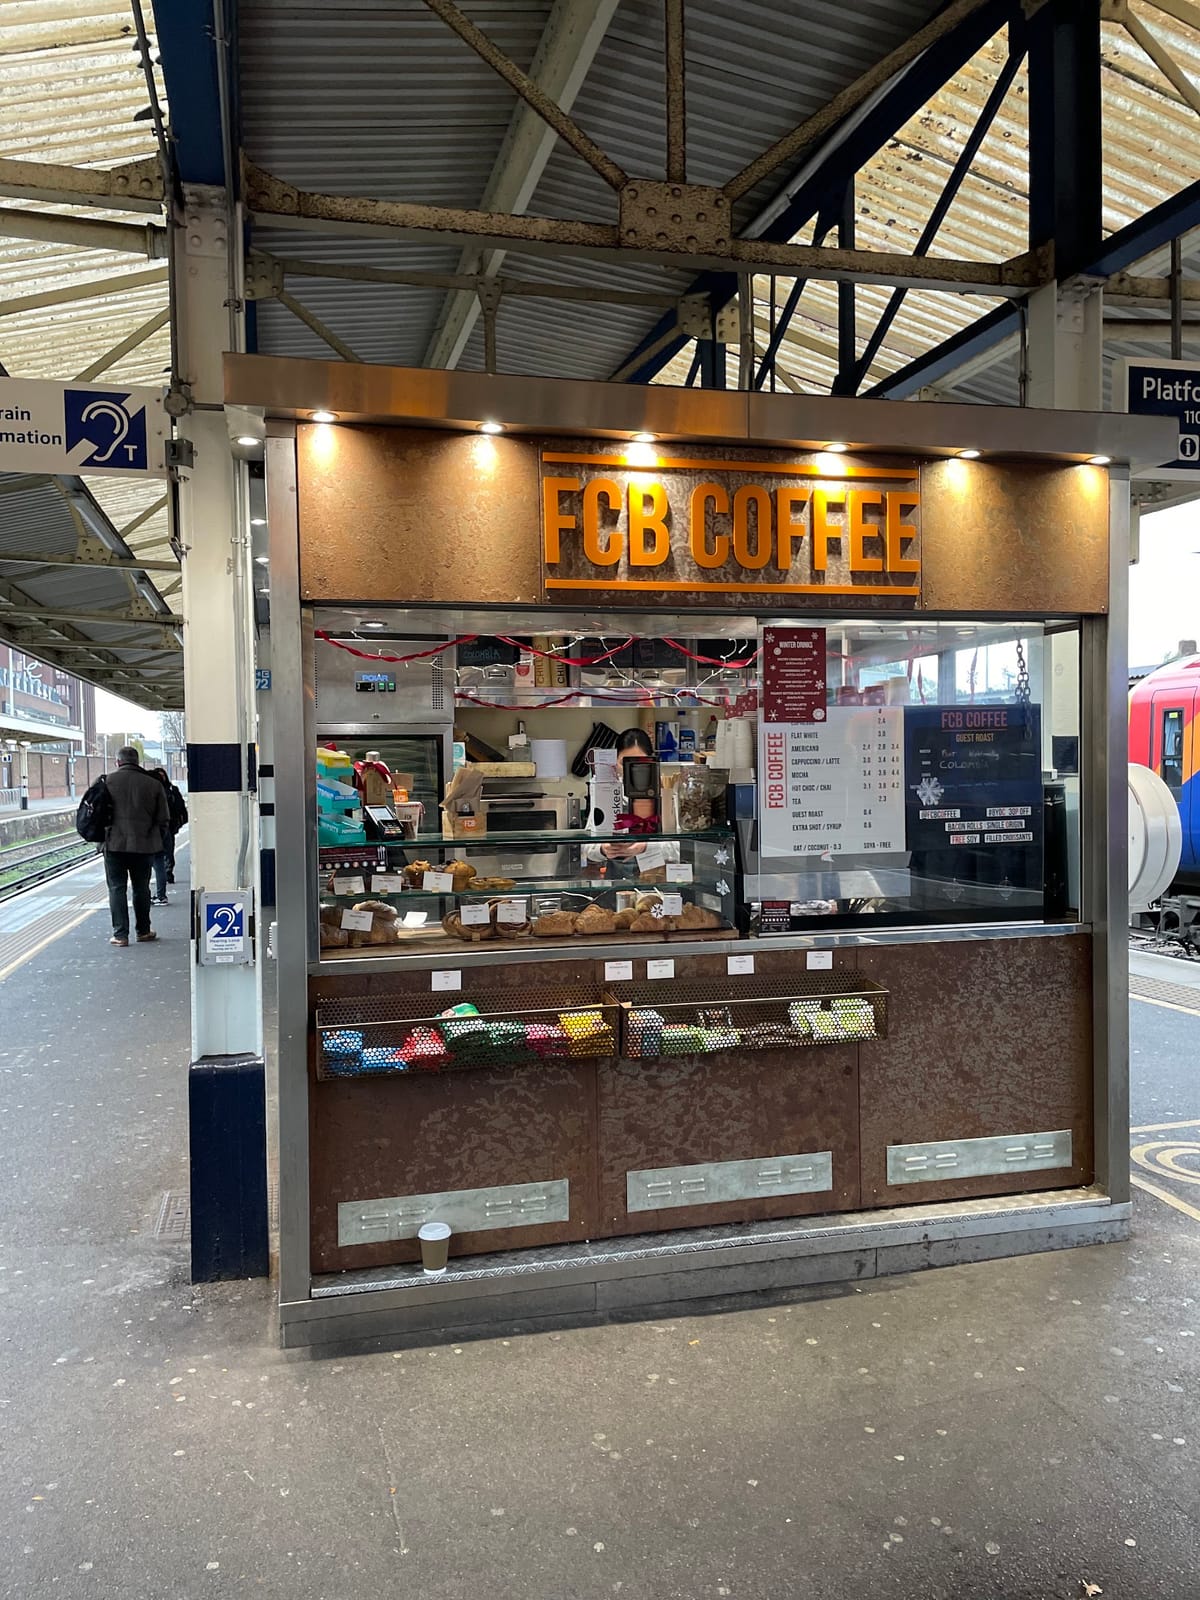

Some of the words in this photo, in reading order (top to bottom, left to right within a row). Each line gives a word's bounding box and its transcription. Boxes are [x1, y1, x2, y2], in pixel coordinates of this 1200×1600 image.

[0, 430, 62, 445] mation
[123, 444, 138, 462] T
[543, 476, 670, 566] FCB
[690, 482, 921, 572] COFFEE
[941, 712, 963, 729] FCB
[966, 711, 1008, 727] COFFEE
[791, 731, 802, 739] FLAT
[803, 731, 818, 739] WHITE
[955, 733, 975, 742] GUEST
[975, 733, 994, 742] ROAST
[768, 732, 784, 780] COFFEE
[768, 784, 784, 808] FCB
[947, 822, 966, 831] BACON
[966, 821, 983, 830] ROLLS
[986, 820, 1004, 829] SINGLE
[952, 835, 966, 843] FREE
[966, 834, 978, 843] SOY
[986, 834, 1002, 842] FILLED
[1002, 833, 1031, 842] CROISSANTS
